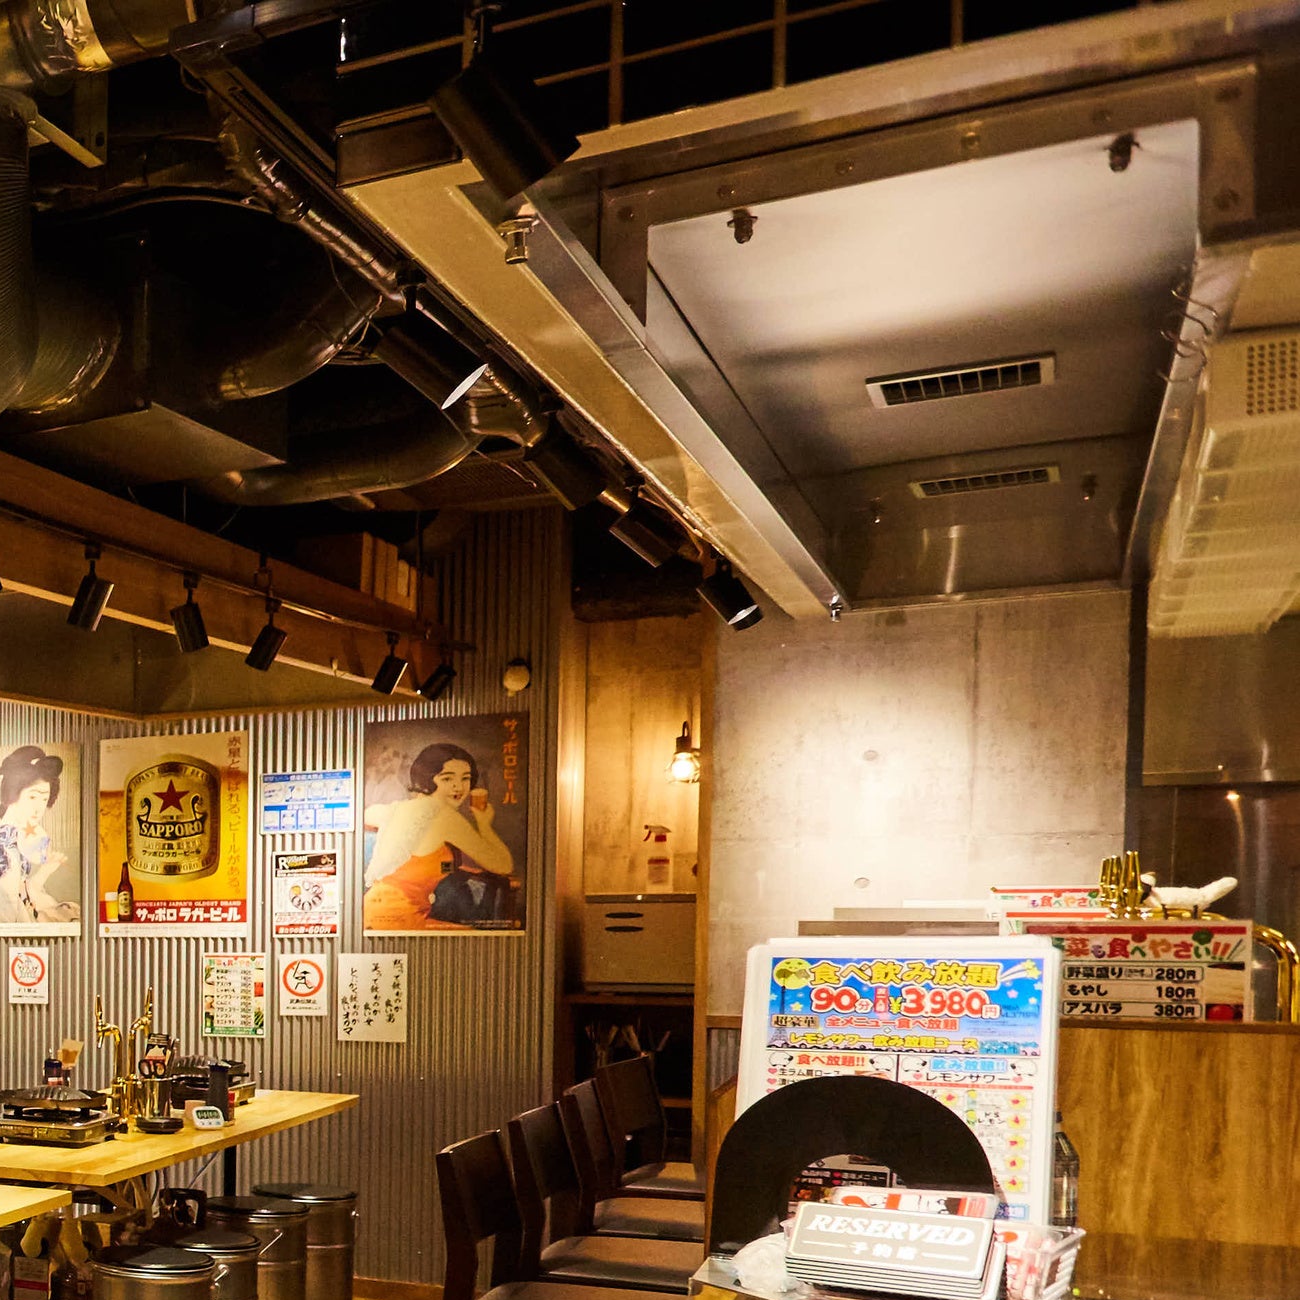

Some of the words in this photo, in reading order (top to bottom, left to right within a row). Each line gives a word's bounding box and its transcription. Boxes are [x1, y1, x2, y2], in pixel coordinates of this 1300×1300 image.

[502, 719, 519, 805] サッポロビール
[227, 736, 242, 894] 赤星とばれる、ビールがある。
[141, 822, 203, 837] SAPPORO
[136, 907, 177, 922] サッポロ
[178, 906, 241, 922] ラガービール
[810, 961, 1002, 987] 食べ飲み放題
[1067, 966, 1124, 979] 野菜盛り
[1155, 968, 1196, 981] 280円
[1067, 984, 1108, 997] もやし
[1156, 986, 1196, 998] 180円
[1066, 1002, 1123, 1015] アスパラ
[1154, 1003, 1195, 1017] 380円
[773, 1015, 818, 1028] 超豪華
[826, 1016, 960, 1031] 全メニュー食べ放題
[789, 1032, 979, 1049] レモンサワー飲み放題コース
[796, 1053, 866, 1067] 食べ放題!!
[925, 1072, 1011, 1084] レモンサワー
[806, 1214, 976, 1247] RESERVED
